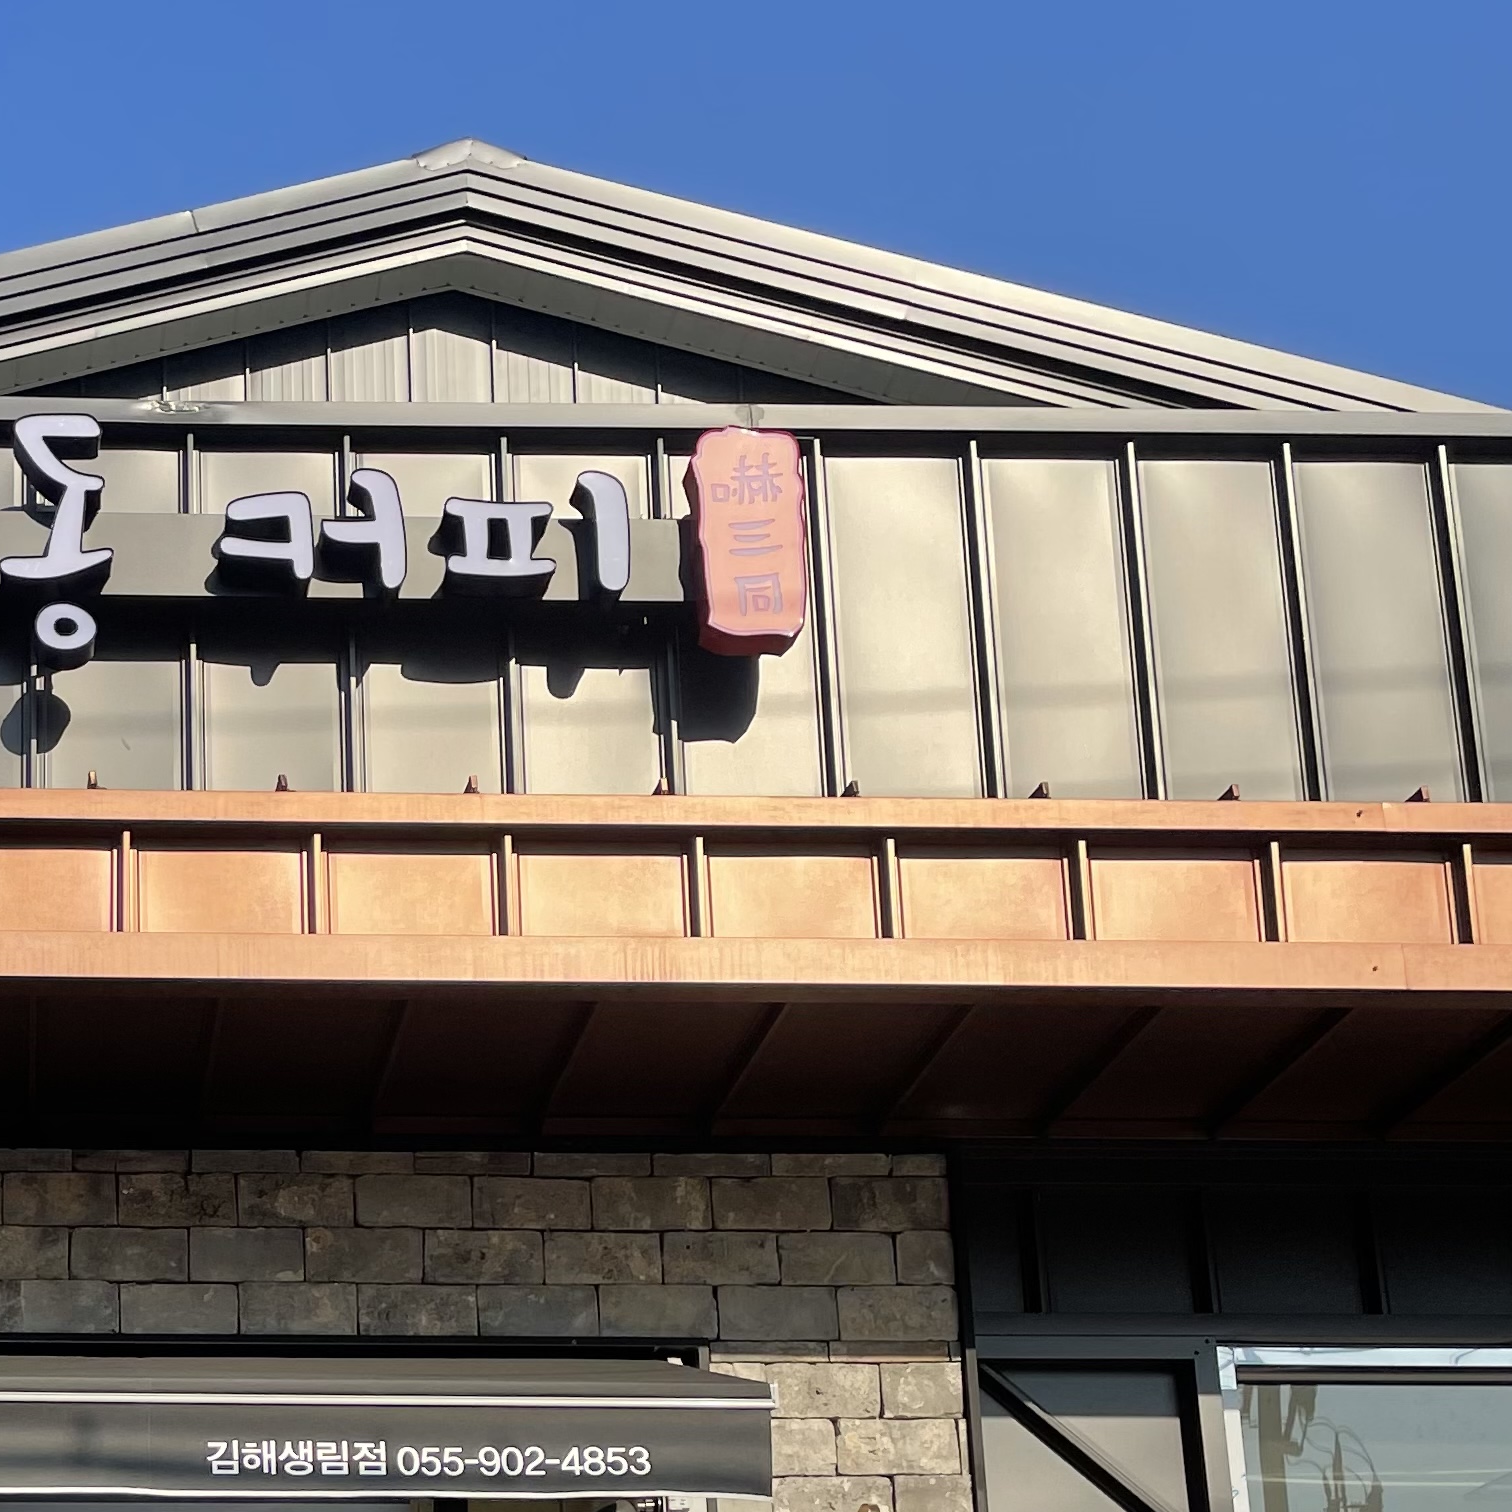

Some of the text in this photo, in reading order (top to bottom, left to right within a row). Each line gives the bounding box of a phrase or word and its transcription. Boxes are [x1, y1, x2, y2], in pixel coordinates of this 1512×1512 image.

[220, 467, 631, 592] 커피
[206, 1439, 652, 1477] 김해생림점 055-902-4853
